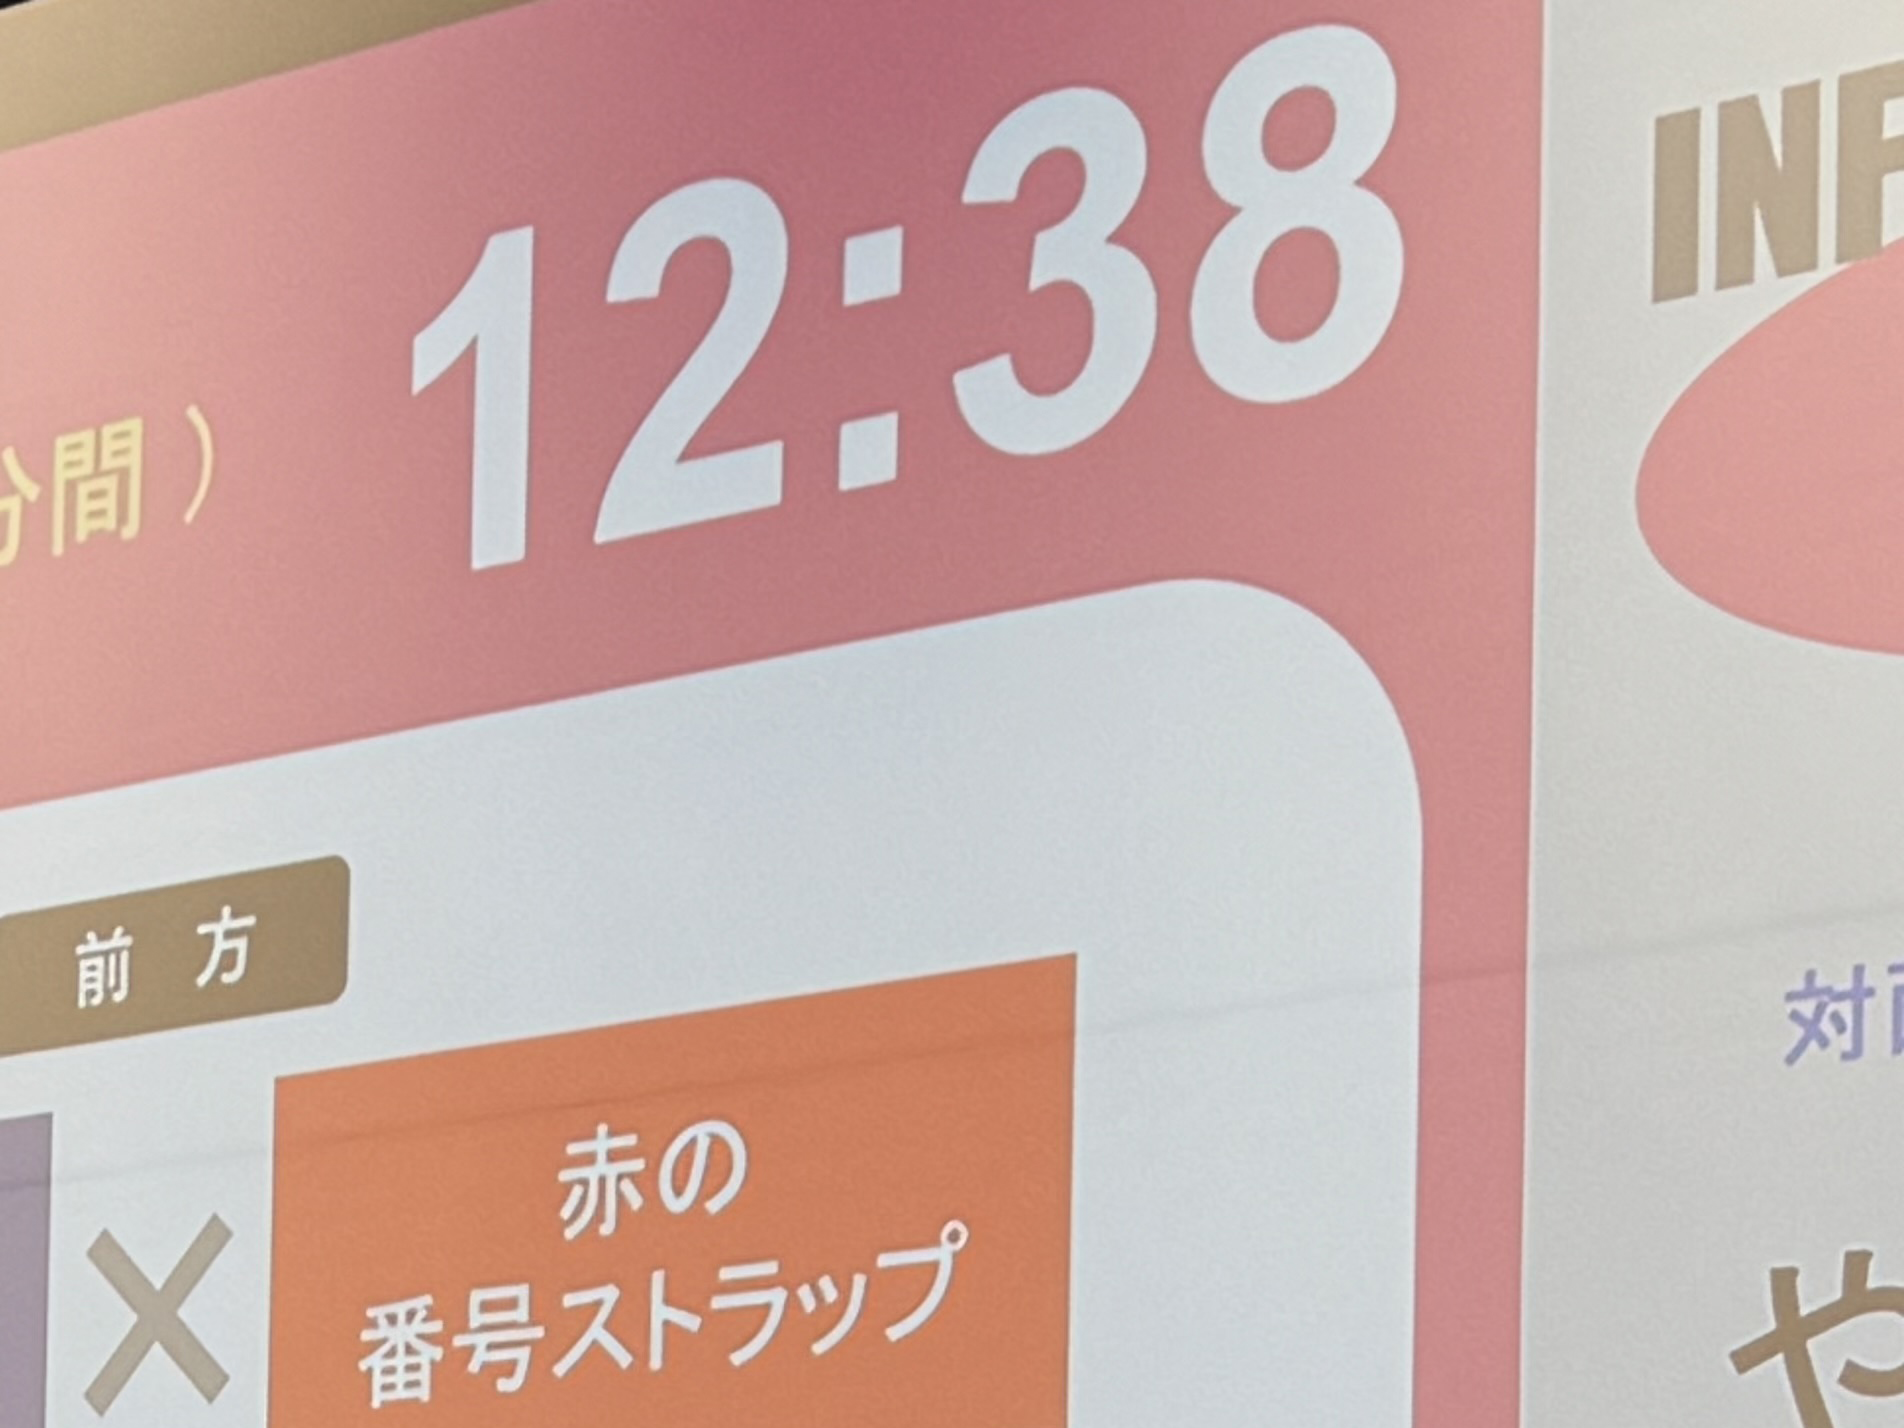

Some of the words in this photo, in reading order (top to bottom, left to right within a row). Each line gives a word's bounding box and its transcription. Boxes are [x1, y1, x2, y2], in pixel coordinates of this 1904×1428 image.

[411, 24, 1405, 570] 12:38
[1784, 963, 1904, 1067] 対
[558, 1118, 748, 1241] 赤の
[358, 1219, 969, 1409] 番号ストラップ
